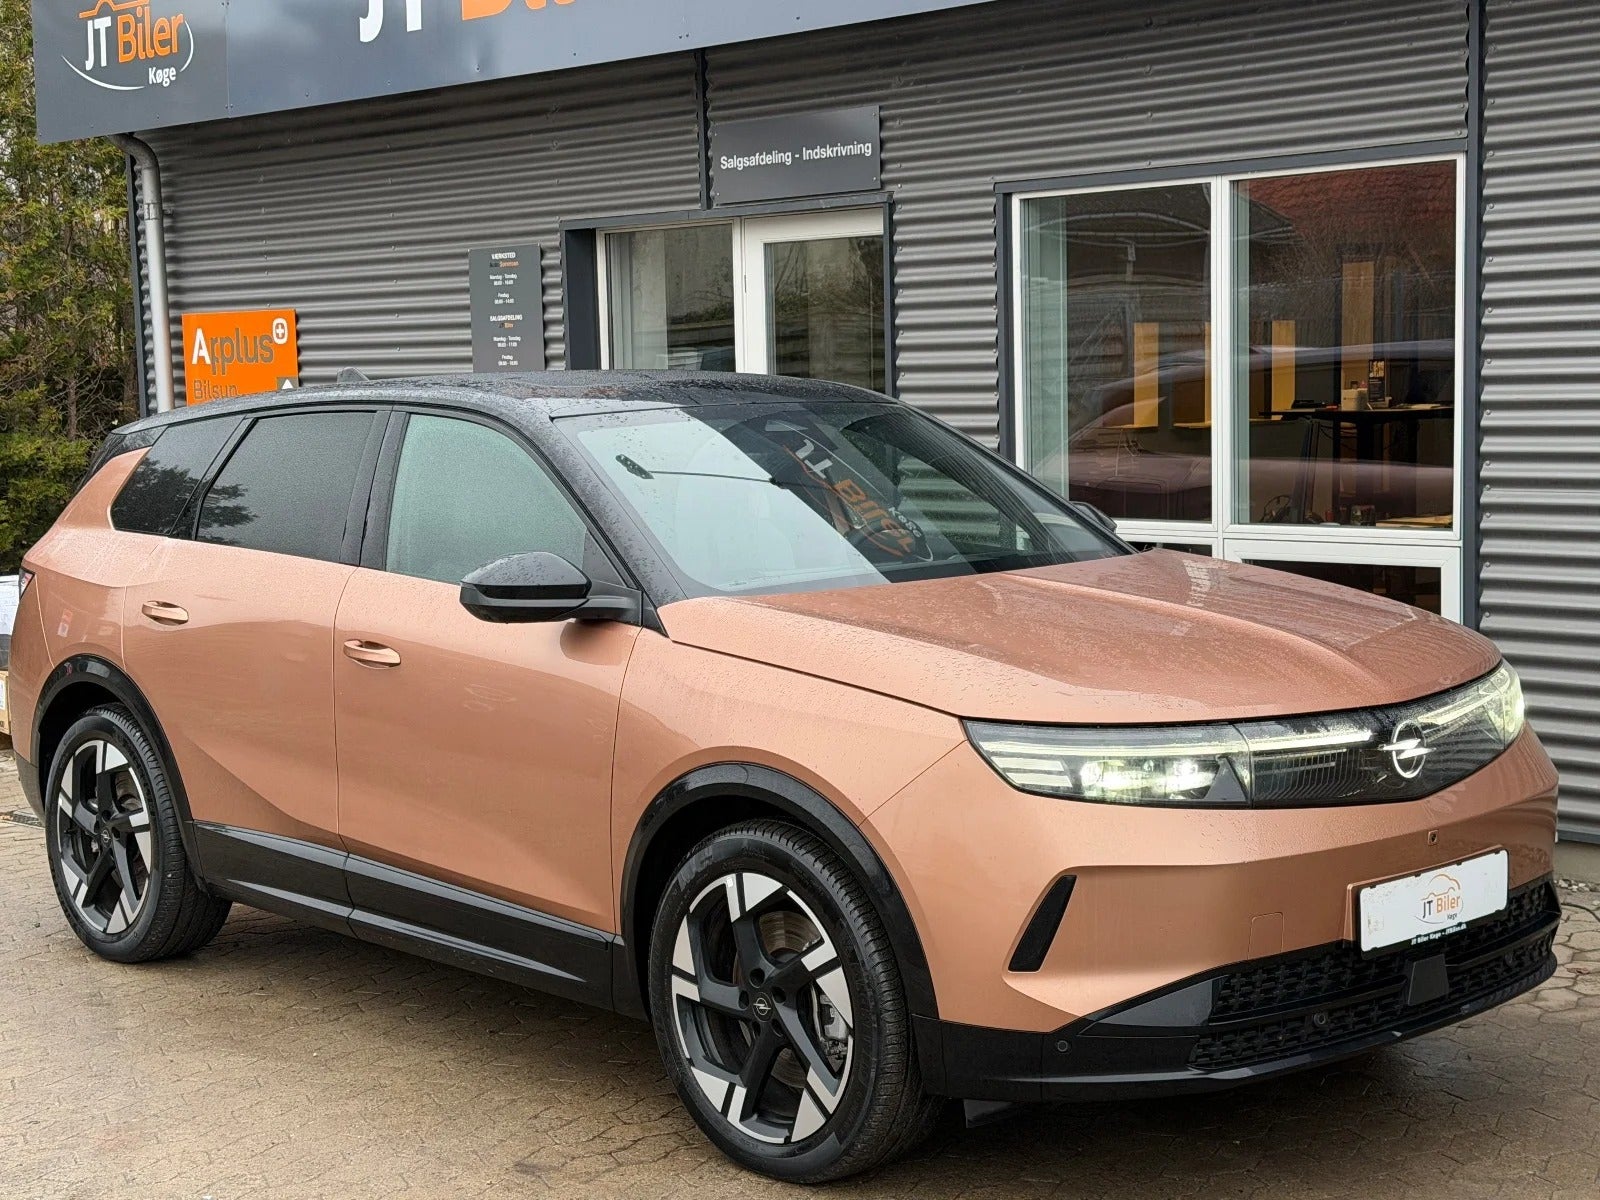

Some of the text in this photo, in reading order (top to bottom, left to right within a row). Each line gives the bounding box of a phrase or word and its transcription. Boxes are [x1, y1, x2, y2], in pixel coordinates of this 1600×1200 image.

[85, 6, 184, 71] JT Biler
[148, 66, 177, 87] Køge
[720, 150, 792, 170] Salgsafdeling
[802, 141, 872, 160] Indskrivning
[1422, 895, 1460, 919] JT Biler
